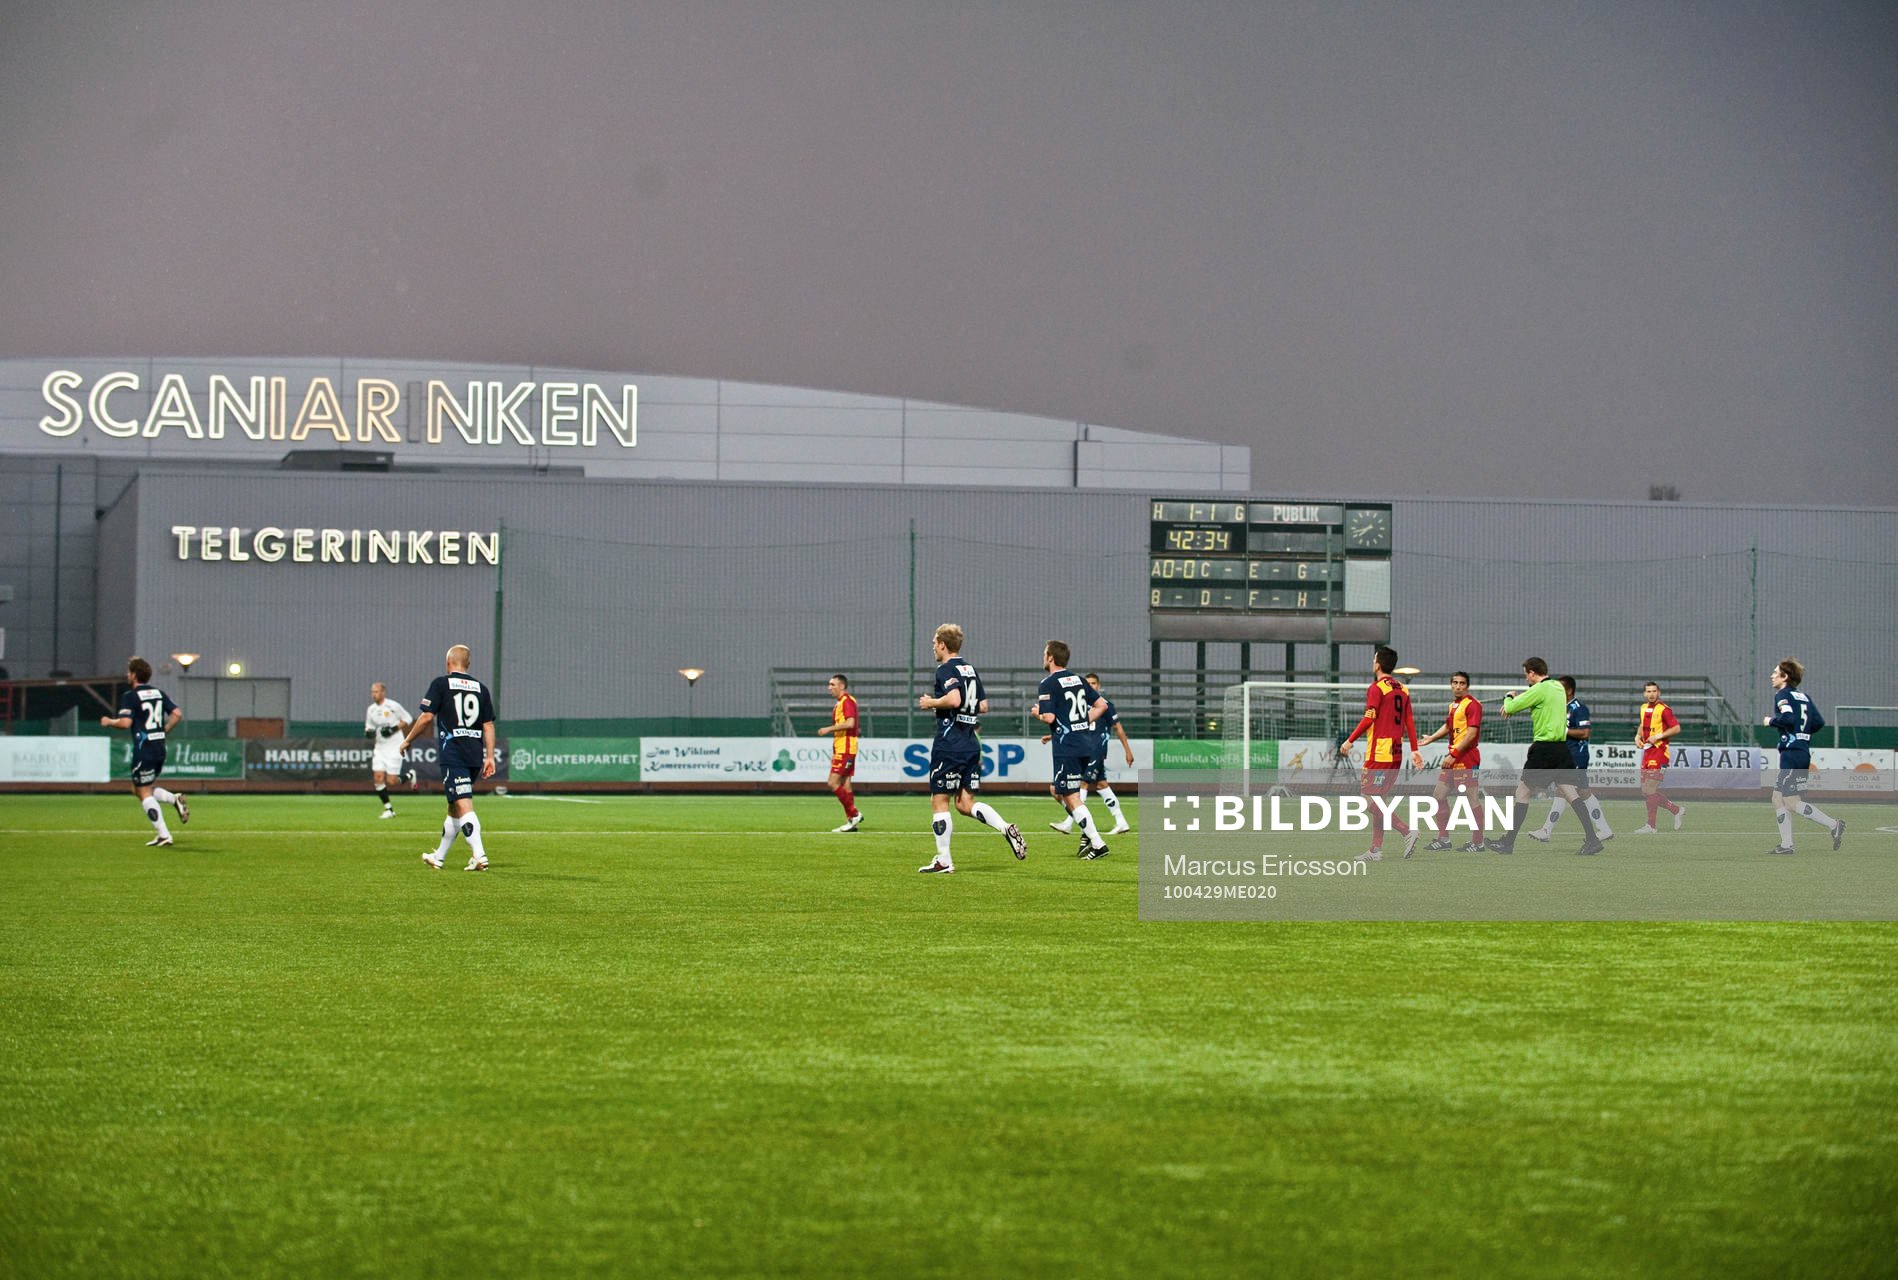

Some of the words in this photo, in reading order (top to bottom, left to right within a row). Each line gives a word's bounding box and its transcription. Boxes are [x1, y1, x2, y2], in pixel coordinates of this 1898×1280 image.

[1153, 504, 1163, 520] H
[1273, 506, 1319, 522] PUBLIK
[171, 526, 499, 565] TELGERINKEN
[1169, 530, 1229, 550] 42:34
[141, 700, 163, 730] 24
[453, 692, 480, 727] 19
[1064, 689, 1087, 722] 26
[1394, 694, 1403, 726] 9
[1800, 703, 1808, 732] 5
[176, 744, 228, 765] Hanna
[536, 754, 639, 765] CENTERPARTIET
[902, 744, 1025, 777] SSP
[1608, 746, 1636, 759] Bar
[1699, 749, 1751, 769] BAR
[1602, 761, 1637, 770] Nightclub
